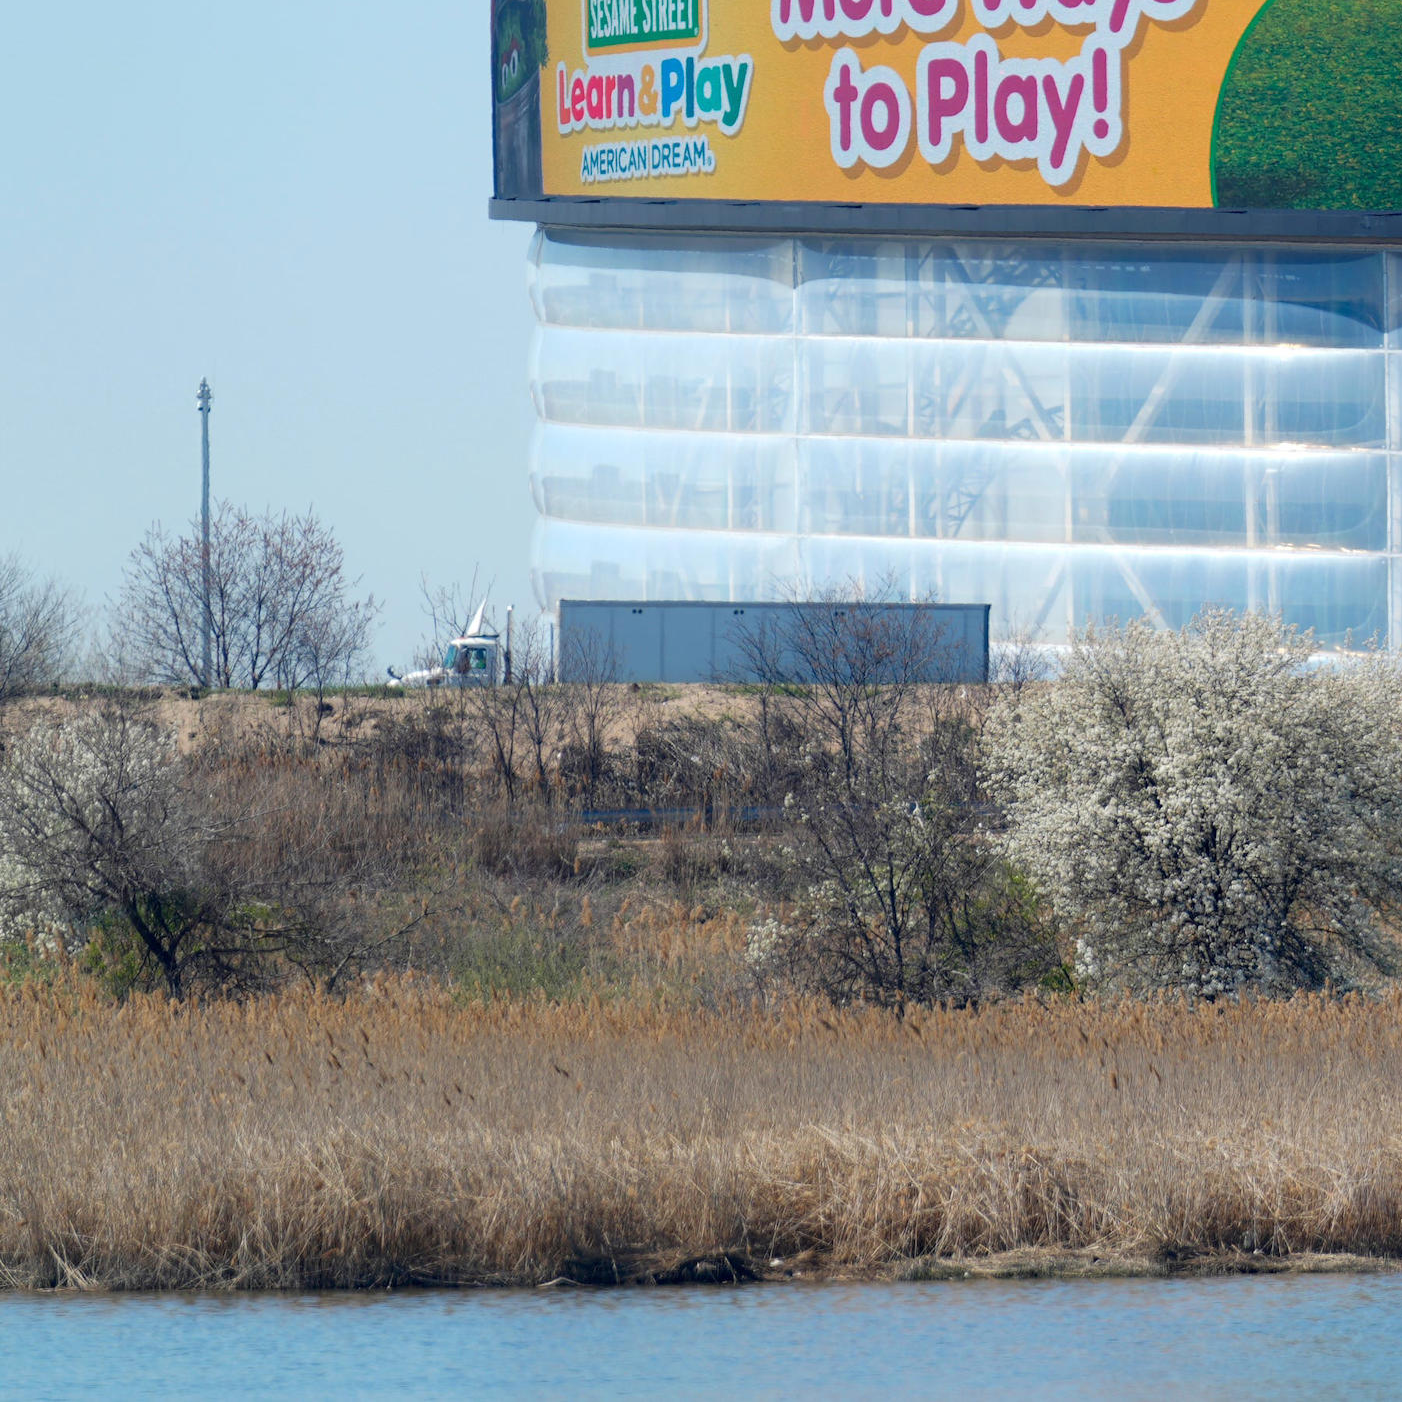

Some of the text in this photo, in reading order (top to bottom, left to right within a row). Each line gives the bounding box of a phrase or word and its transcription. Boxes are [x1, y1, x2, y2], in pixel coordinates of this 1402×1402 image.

[832, 46, 1110, 170] to Play!
[581, 141, 706, 177] AMERICAN DREAM
